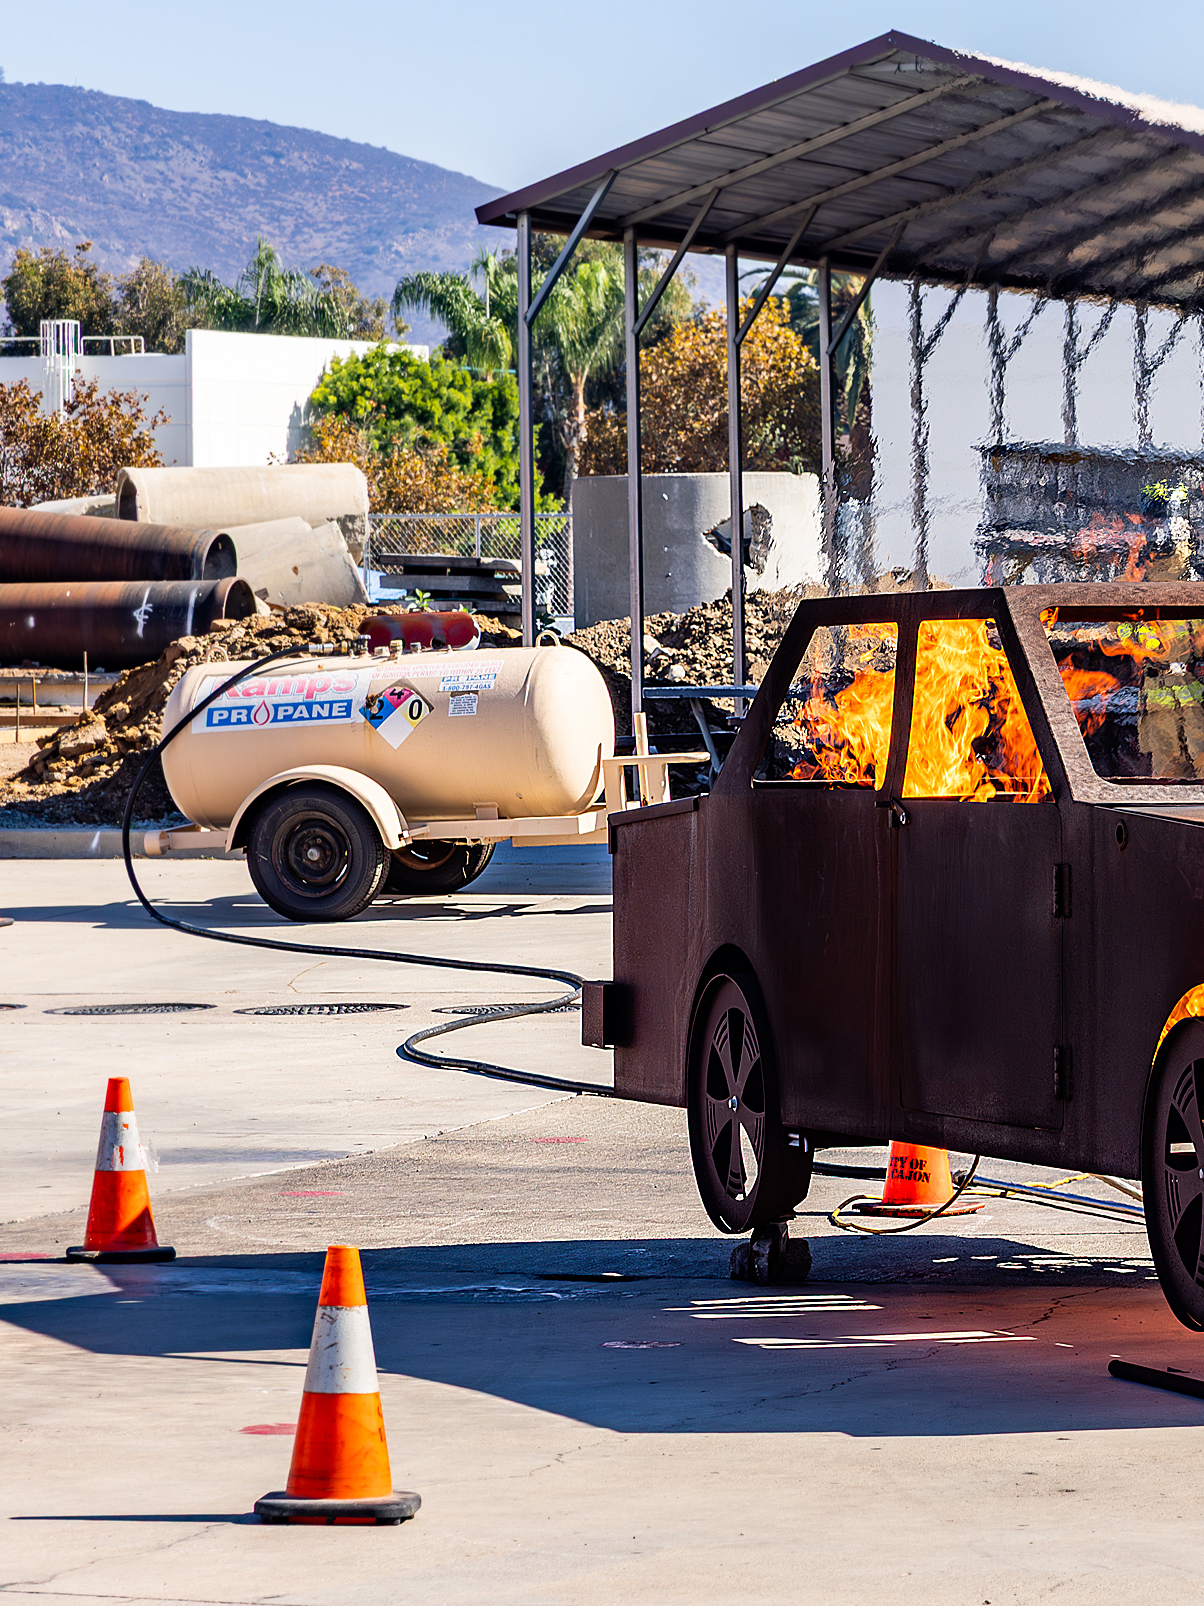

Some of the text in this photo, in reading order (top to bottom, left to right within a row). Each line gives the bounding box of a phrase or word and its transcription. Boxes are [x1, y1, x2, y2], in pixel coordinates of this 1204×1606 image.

[450, 668, 474, 676] WITHIN
[211, 673, 359, 700] Kamps
[390, 688, 405, 700] 4
[212, 702, 348, 725] PROPANE
[408, 699, 423, 721] 0
[910, 1158, 927, 1170] OF
[891, 1169, 931, 1183] CAJON
